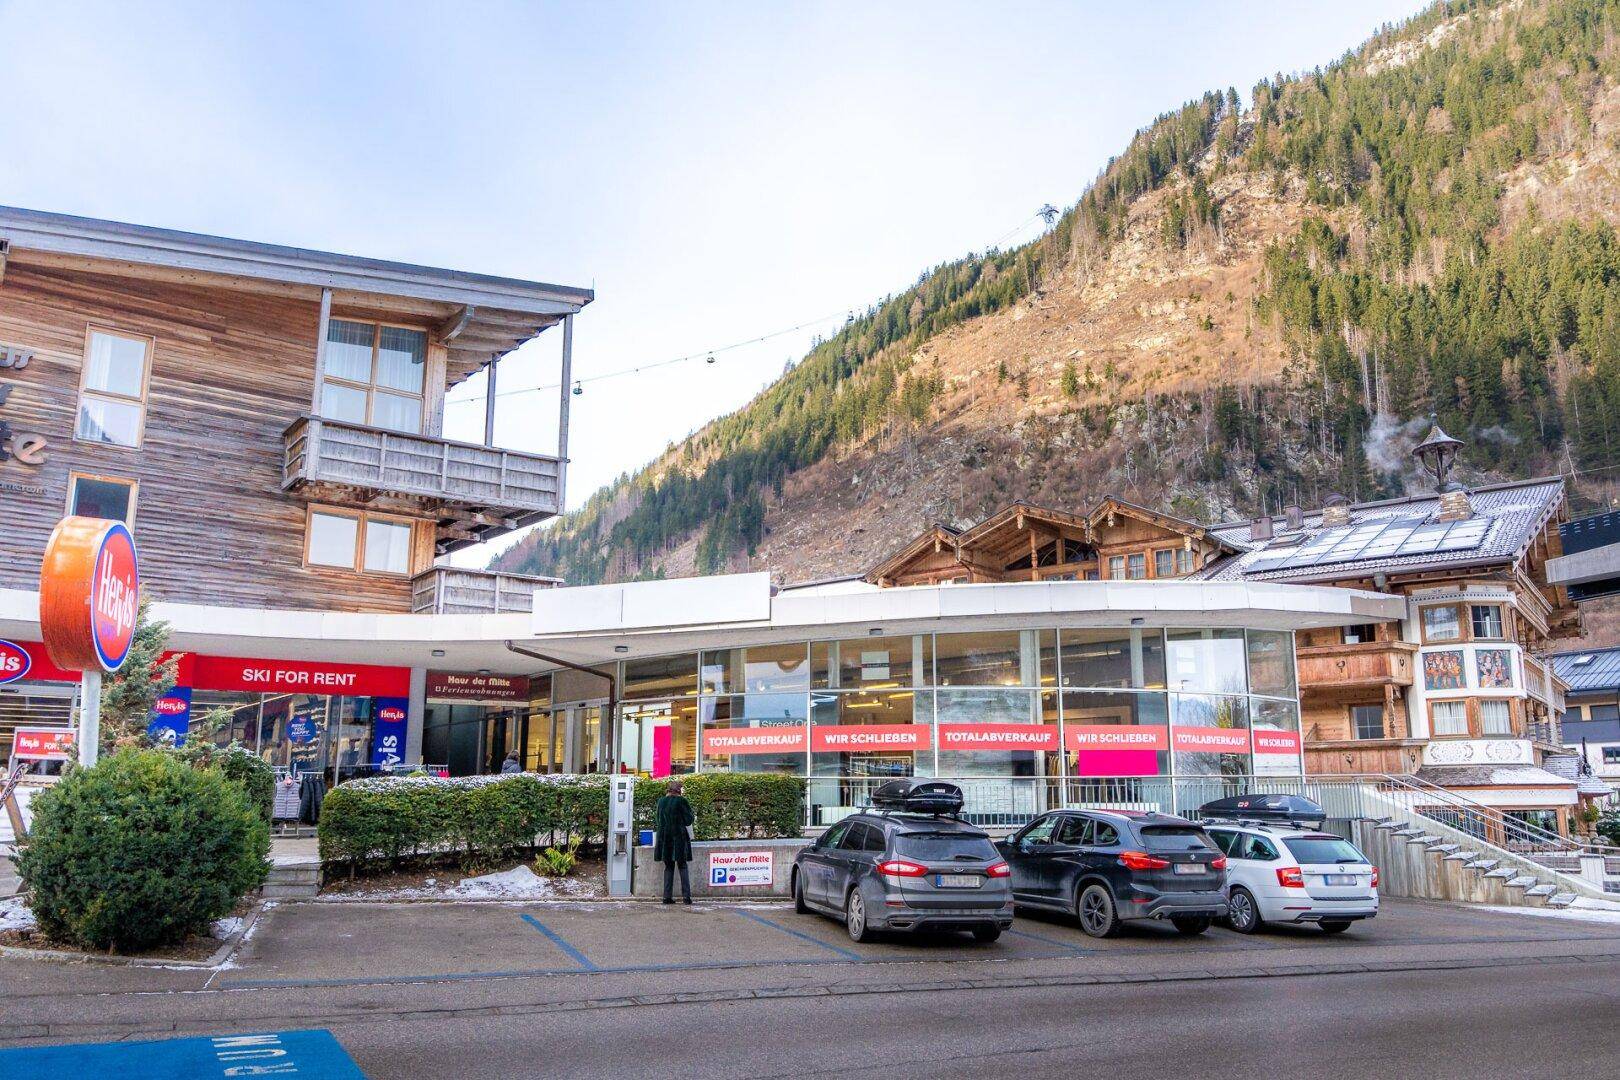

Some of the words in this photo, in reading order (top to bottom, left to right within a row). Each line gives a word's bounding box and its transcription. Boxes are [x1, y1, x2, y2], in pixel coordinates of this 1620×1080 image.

[98, 549, 134, 637] Hervis
[242, 668, 271, 682] SKI
[275, 670, 309, 684] FOR
[313, 672, 357, 686] RENT
[447, 675, 470, 685] Haus
[472, 677, 486, 686] der
[488, 678, 511, 687] Mitte
[156, 700, 187, 711] Hervis
[380, 709, 405, 720] Hervis
[708, 734, 803, 747] TOTALABVERKAUF
[825, 734, 849, 744] WIR
[944, 732, 1052, 743] TOTALABVERKAUF
[1077, 733, 1098, 744] WIR
[1176, 733, 1246, 746] TOTALABVERKAUF
[749, 855, 770, 863] Mitte
[714, 869, 726, 883] P
